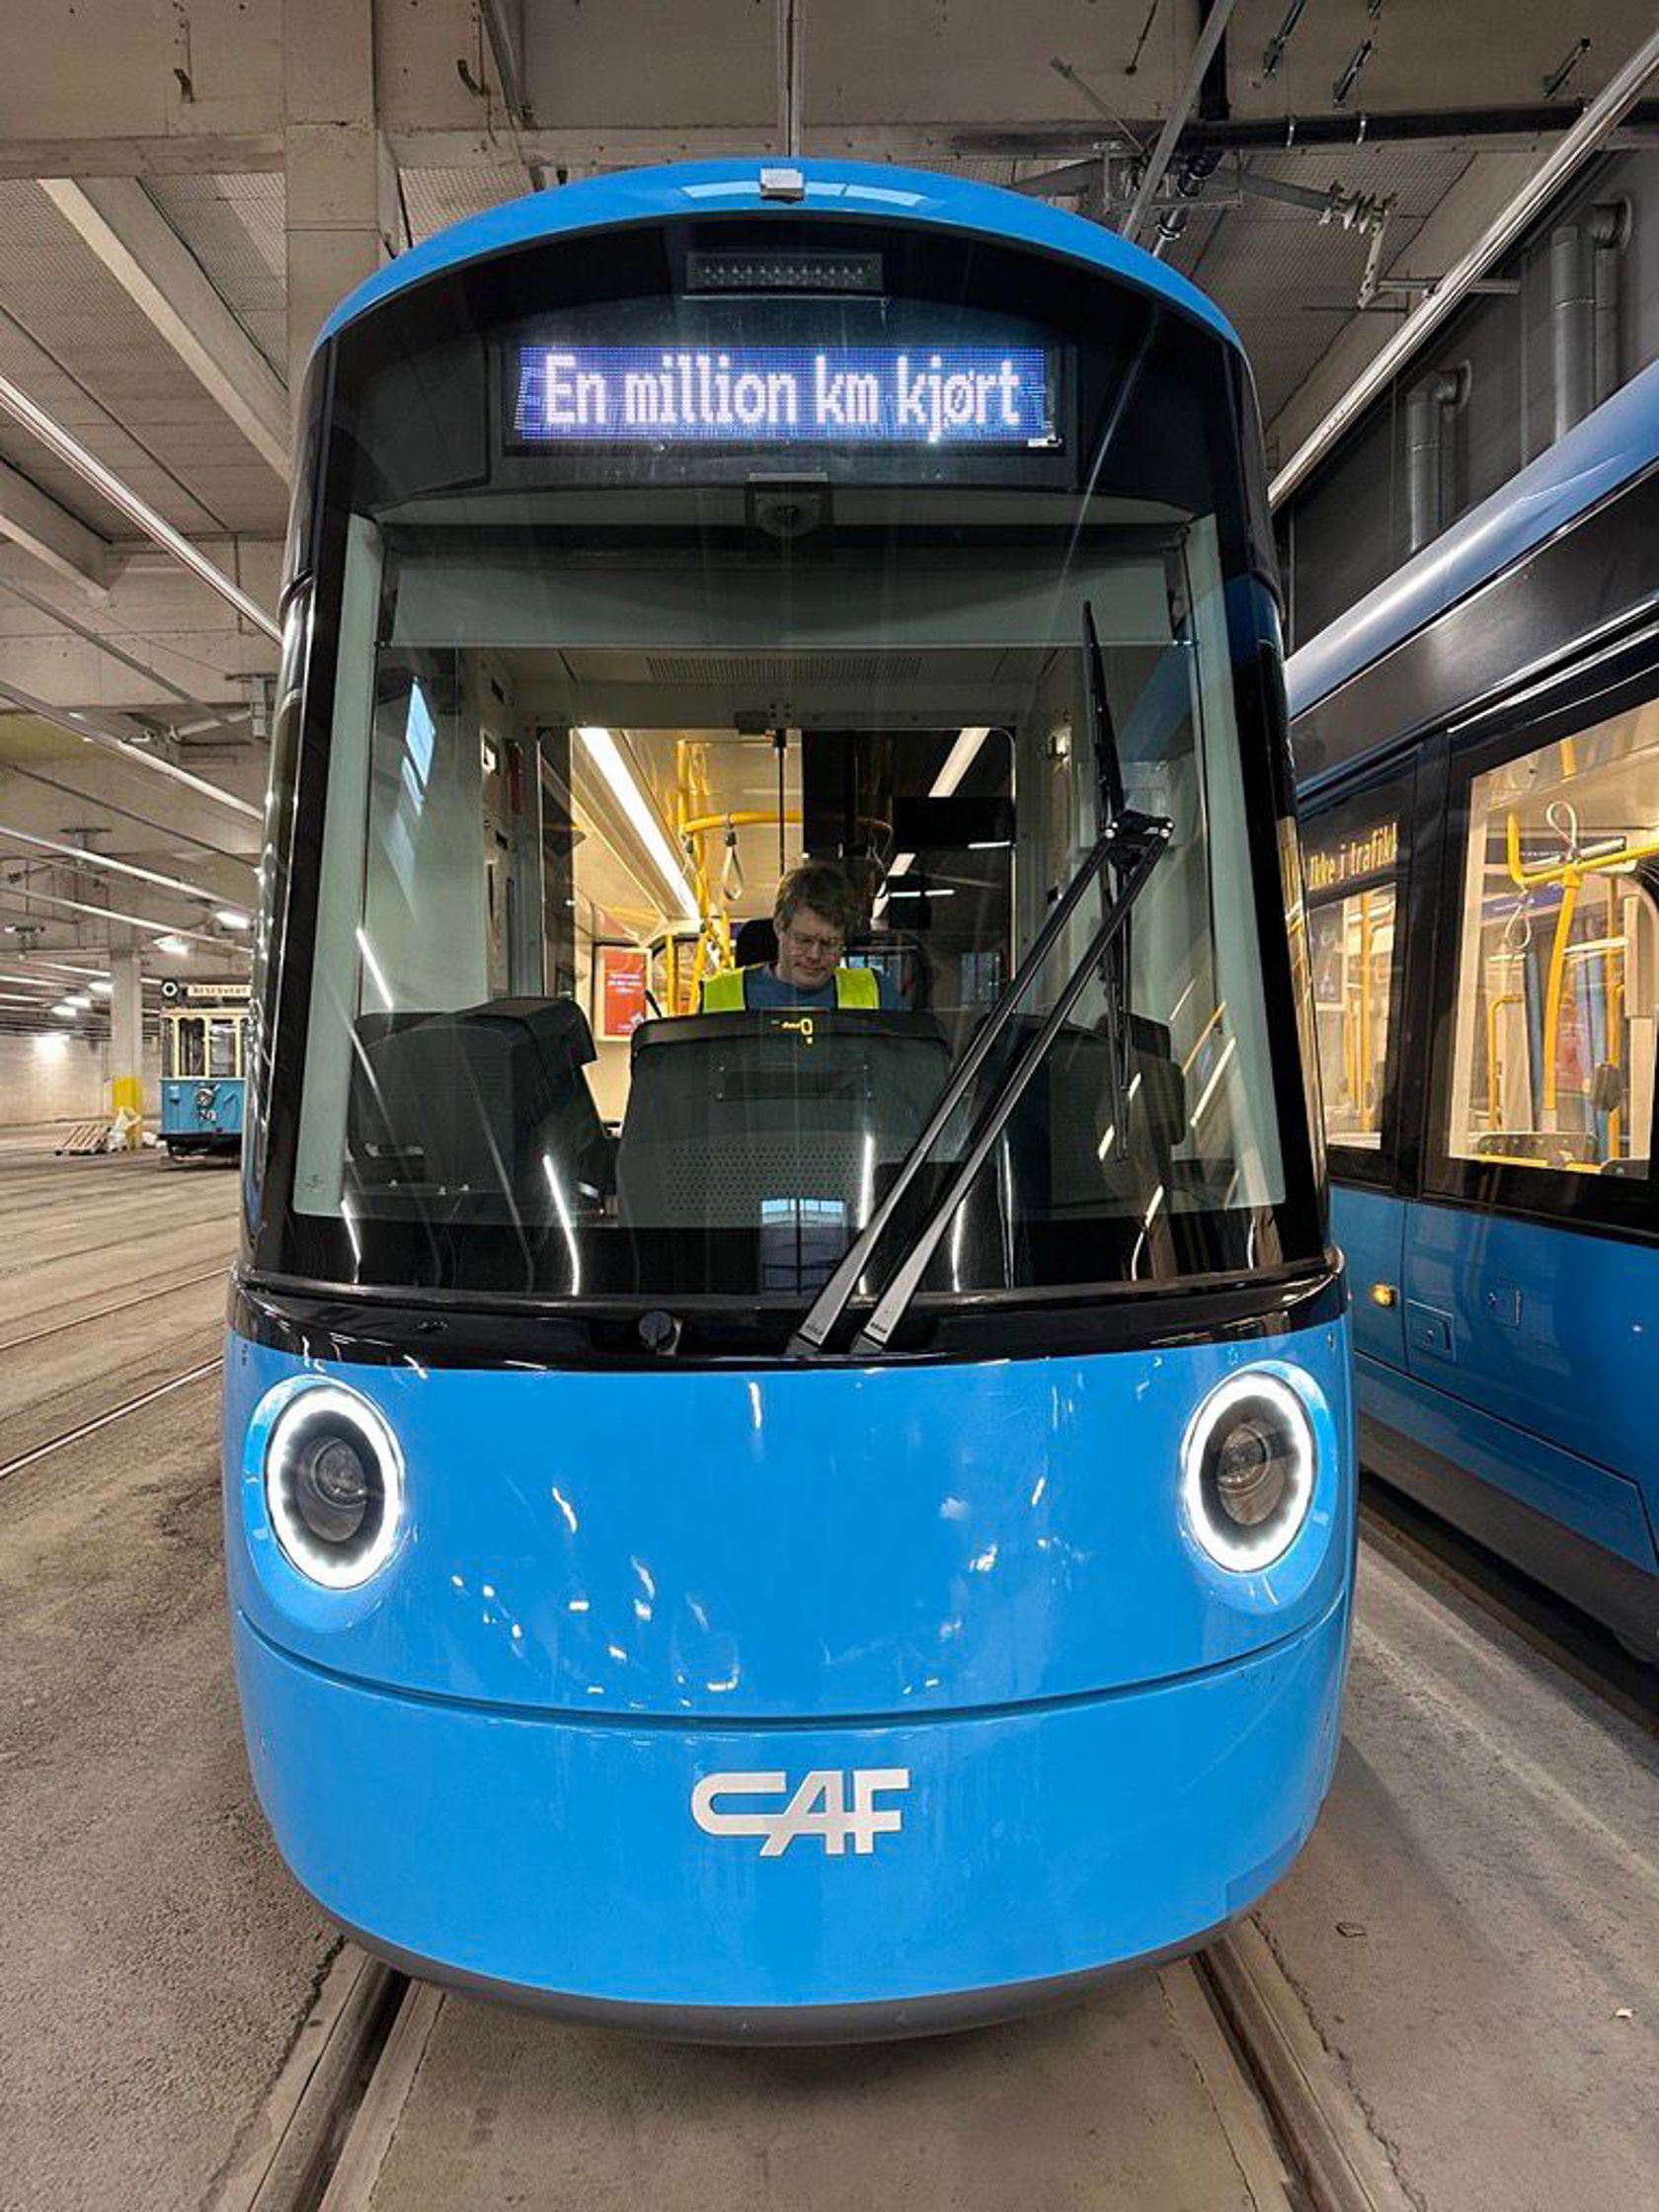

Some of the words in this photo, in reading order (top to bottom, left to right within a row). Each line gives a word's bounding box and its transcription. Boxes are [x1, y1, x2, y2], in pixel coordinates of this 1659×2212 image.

[545, 355, 606, 425] En
[624, 355, 797, 424] million
[815, 355, 878, 424] km
[897, 355, 1020, 443] kjørt
[690, 1768, 910, 1856] CAF
